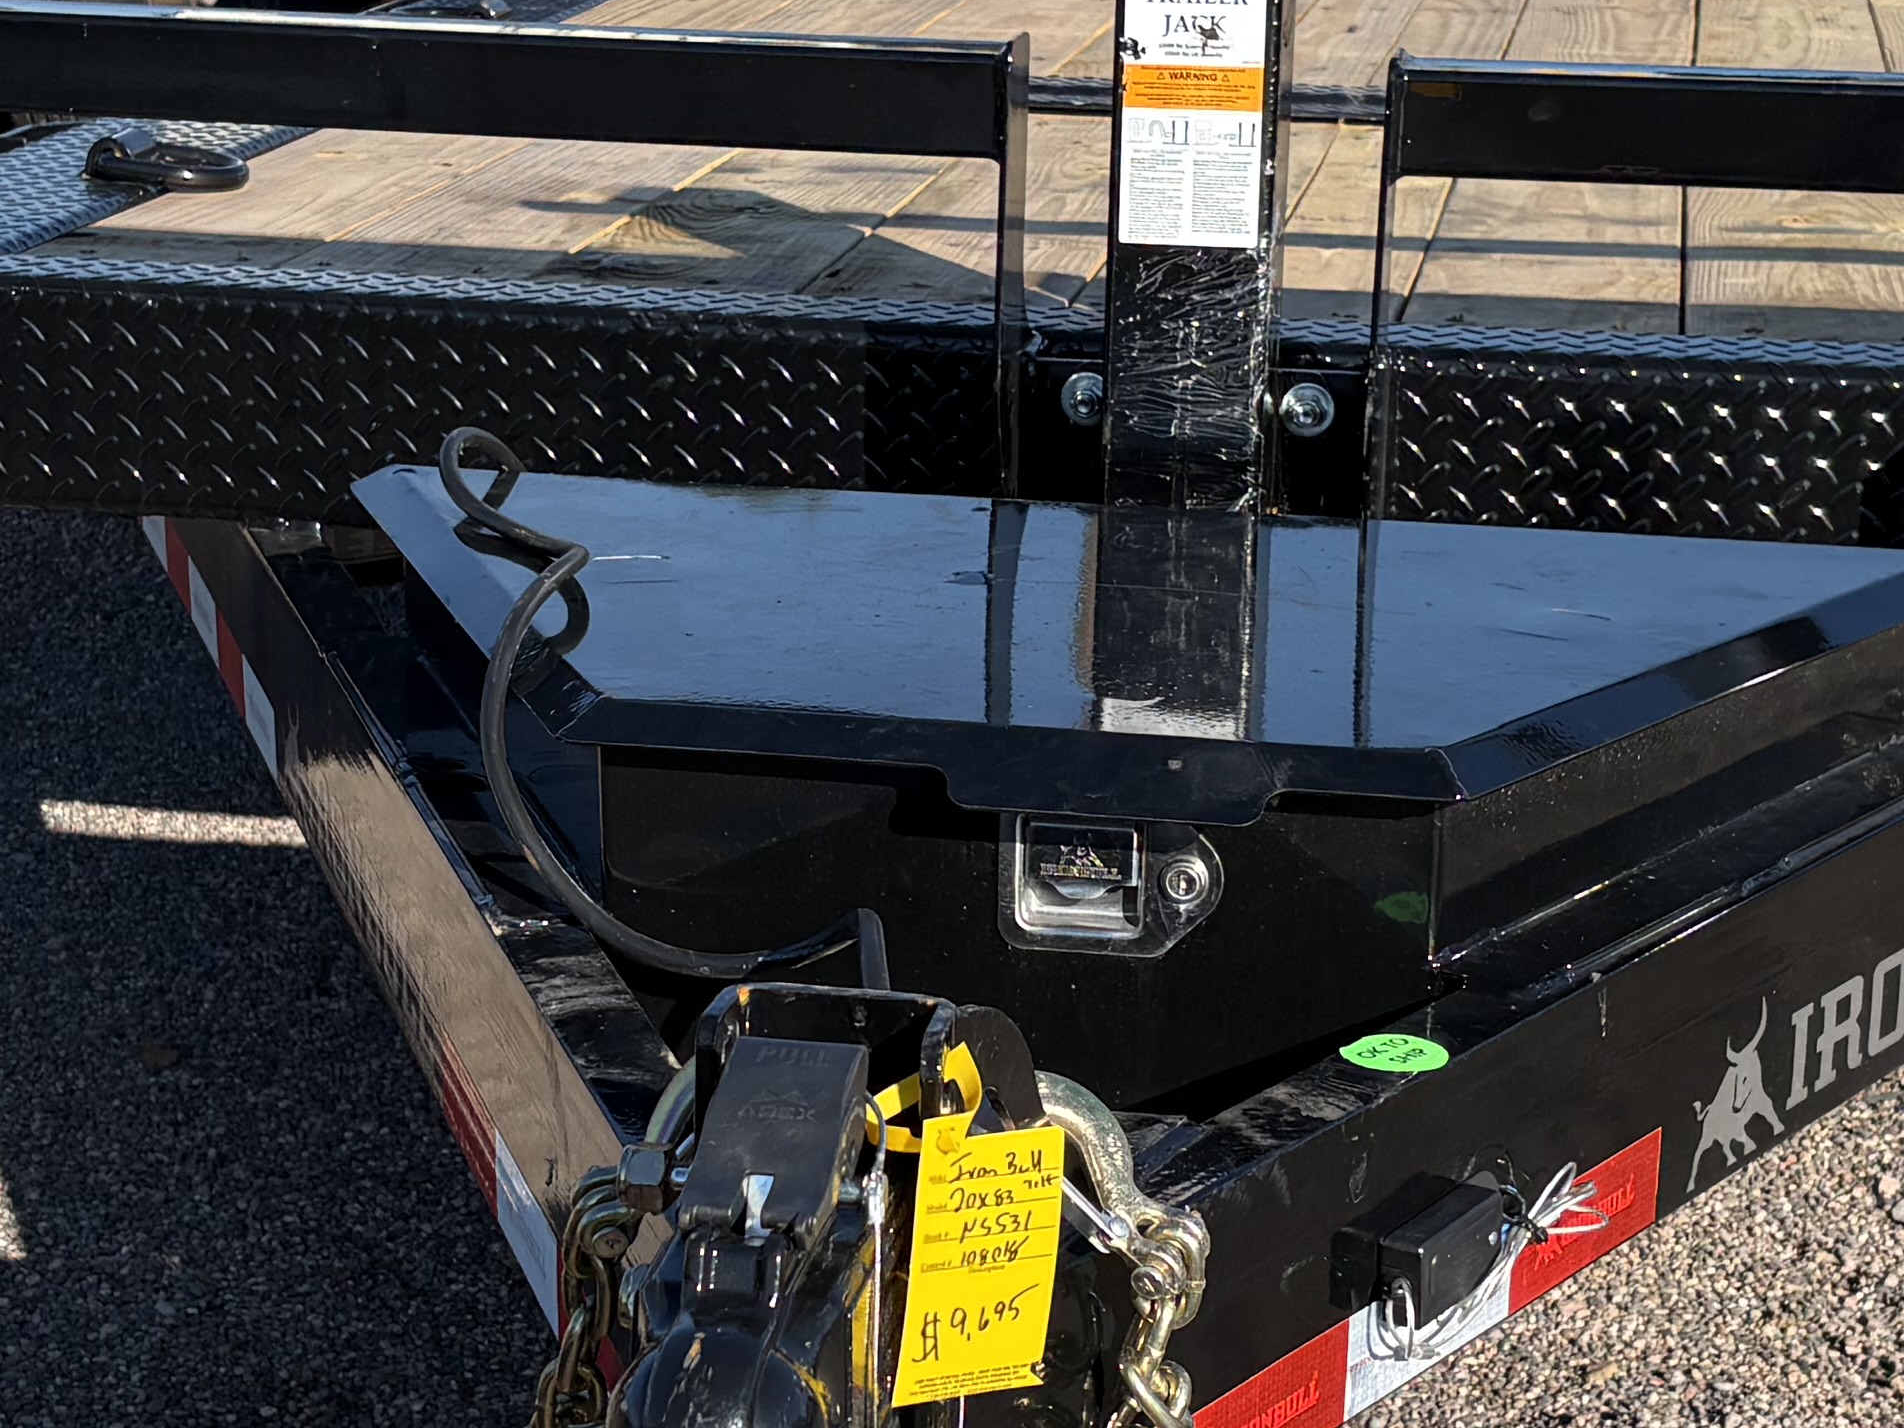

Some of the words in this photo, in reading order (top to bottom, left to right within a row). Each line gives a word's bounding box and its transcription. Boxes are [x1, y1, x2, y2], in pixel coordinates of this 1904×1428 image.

[1162, 13, 1227, 37] JACK
[1168, 71, 1218, 82] WARNING
[1356, 1046, 1389, 1059] OK
[1379, 1037, 1409, 1048] TO
[1388, 1047, 1428, 1064] SHIP
